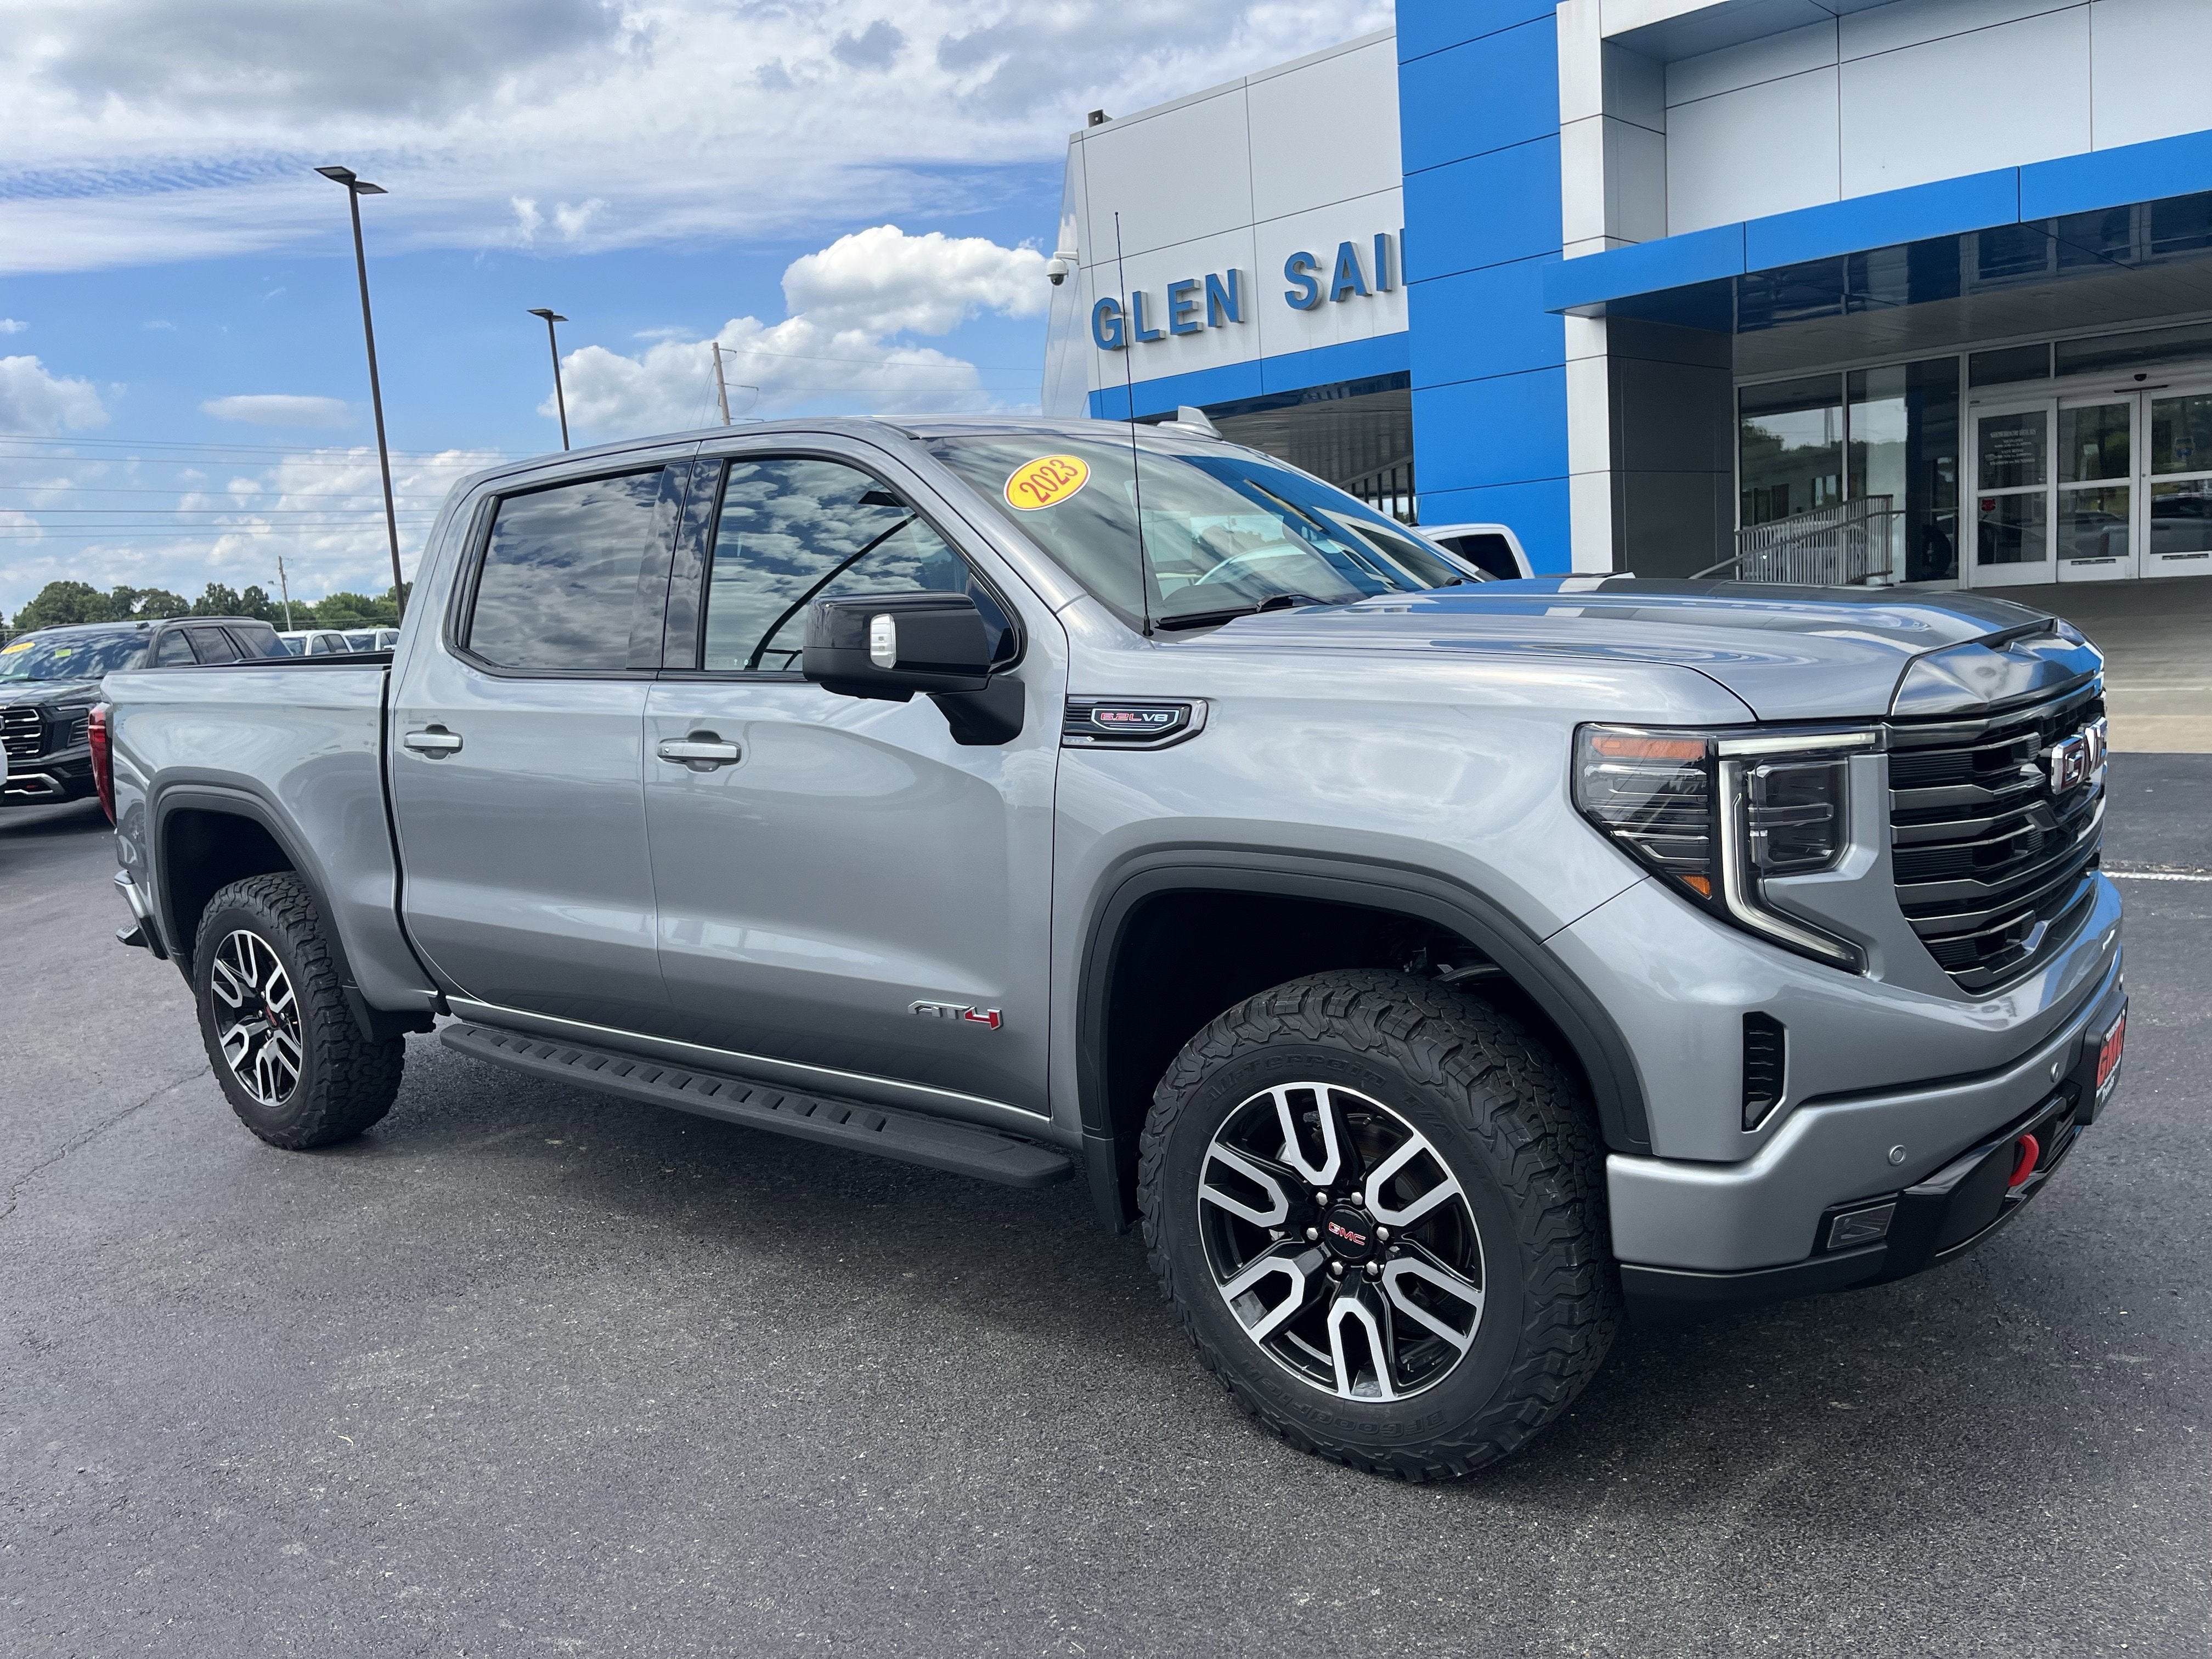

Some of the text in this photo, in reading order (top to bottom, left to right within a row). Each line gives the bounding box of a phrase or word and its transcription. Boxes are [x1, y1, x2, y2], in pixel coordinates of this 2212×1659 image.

[1092, 229, 1407, 351] GLEN SAI
[1019, 459, 1078, 503] 2023
[908, 1000, 1003, 1030] AT4
[2097, 1018, 2125, 1087] GMC
[1328, 1221, 1366, 1246] GMC
